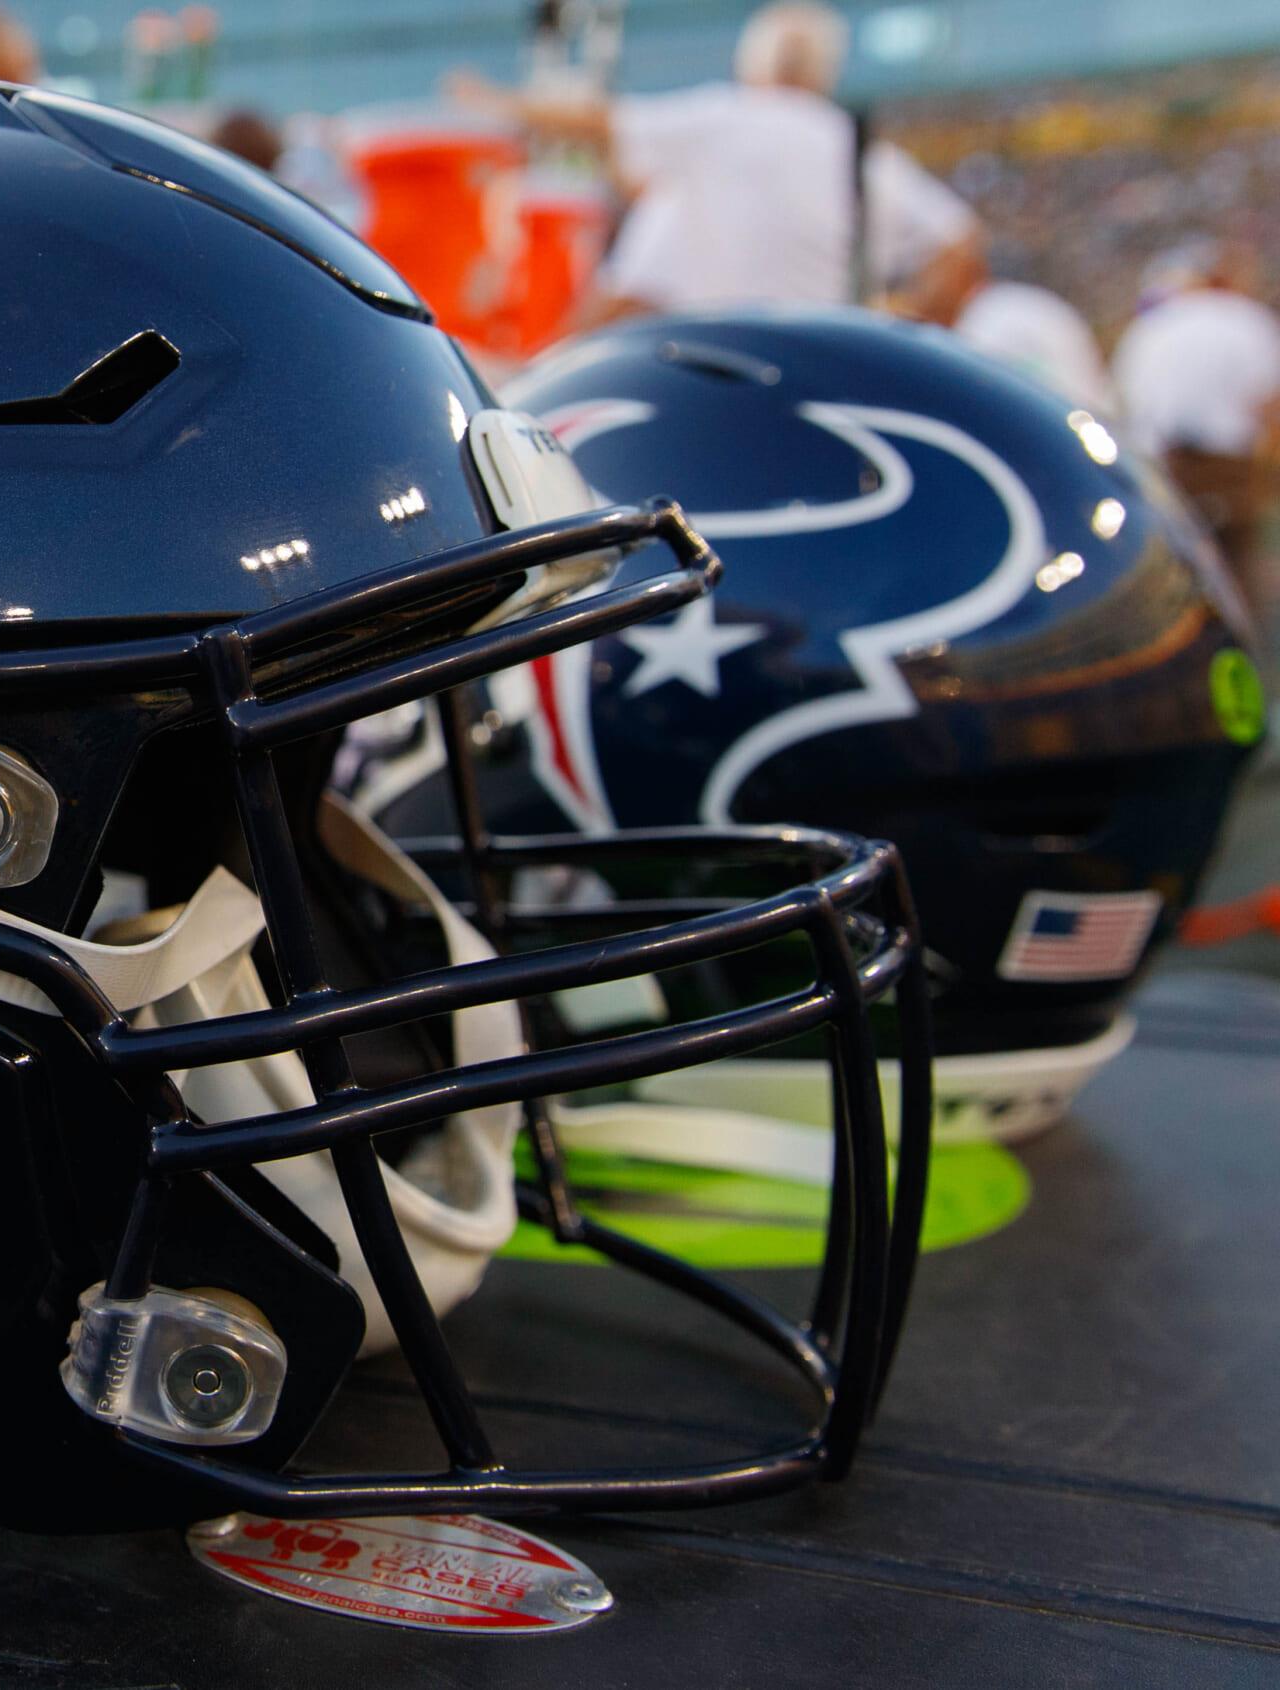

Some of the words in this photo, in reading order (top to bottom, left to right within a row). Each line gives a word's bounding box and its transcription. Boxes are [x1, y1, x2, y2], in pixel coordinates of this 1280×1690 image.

[96, 1319, 140, 1417] Riddell
[371, 1556, 525, 1599] CASES
[440, 1584, 465, 1598] THE
